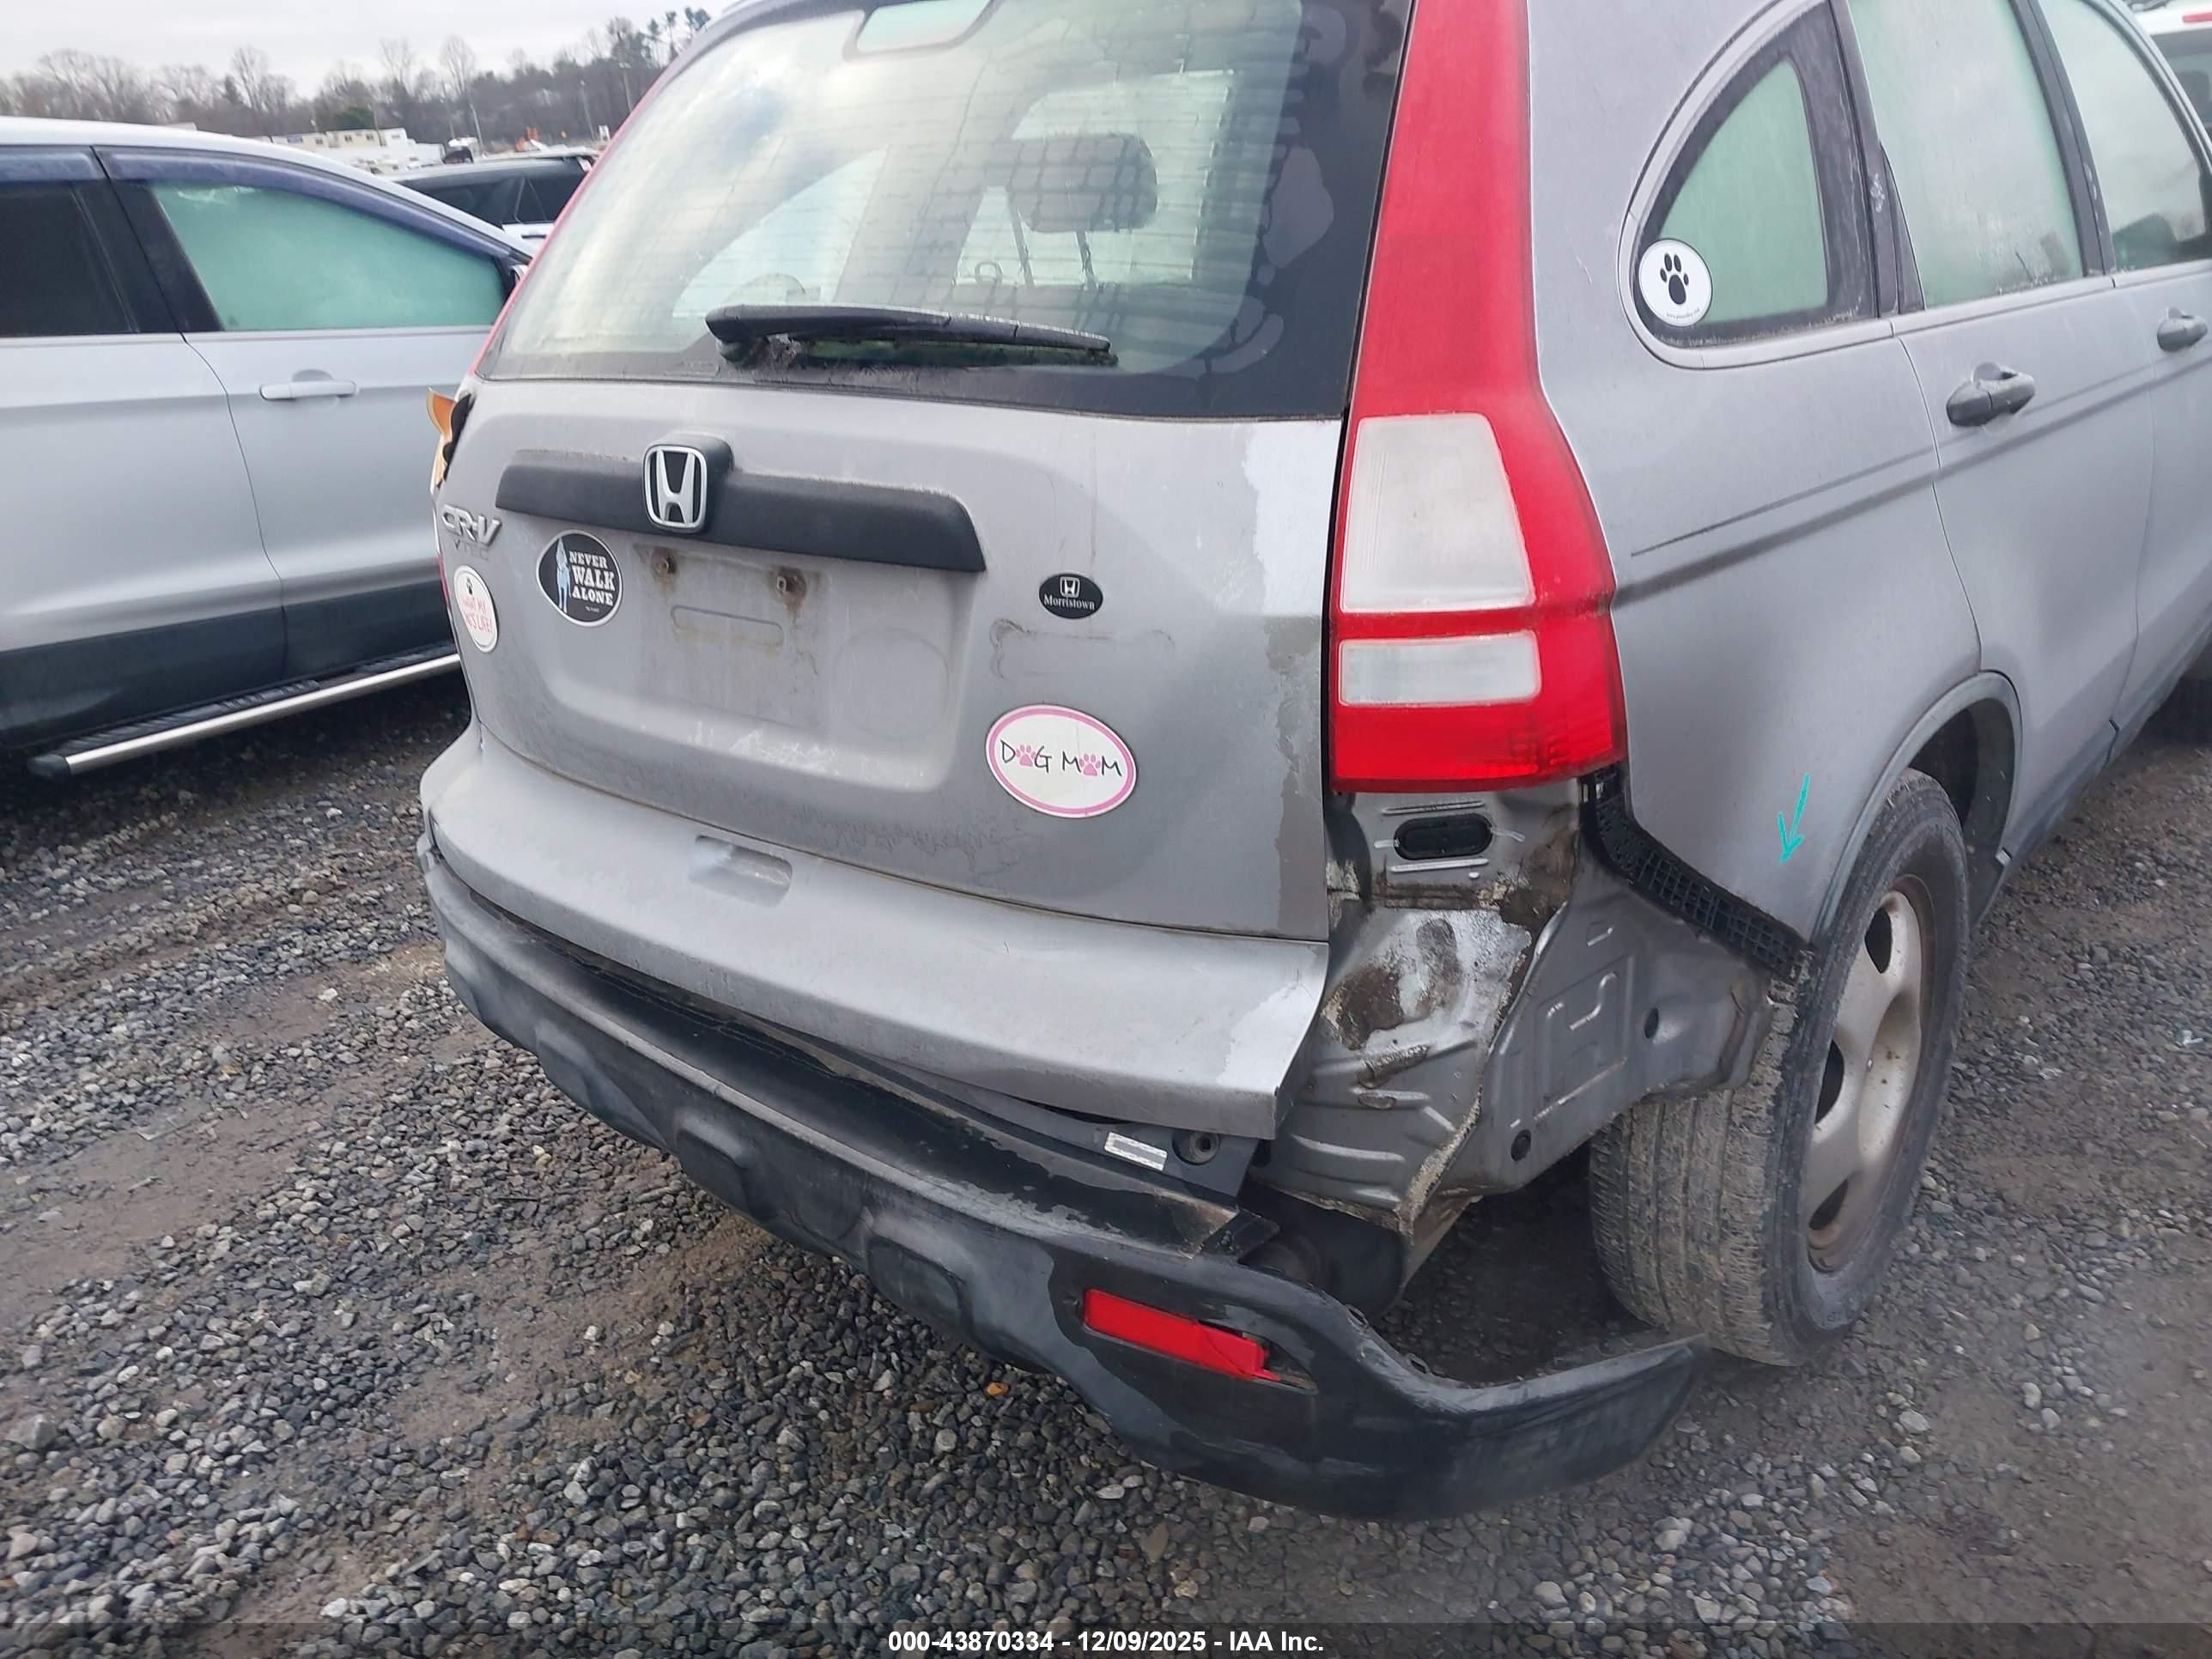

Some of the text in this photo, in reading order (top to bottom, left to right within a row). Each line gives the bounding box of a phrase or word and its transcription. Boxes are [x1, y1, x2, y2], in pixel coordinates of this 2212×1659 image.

[568, 550, 608, 568] NEVER
[572, 565, 615, 591] WALK
[572, 585, 613, 606] ALONE
[1043, 593, 1095, 611] Morristown
